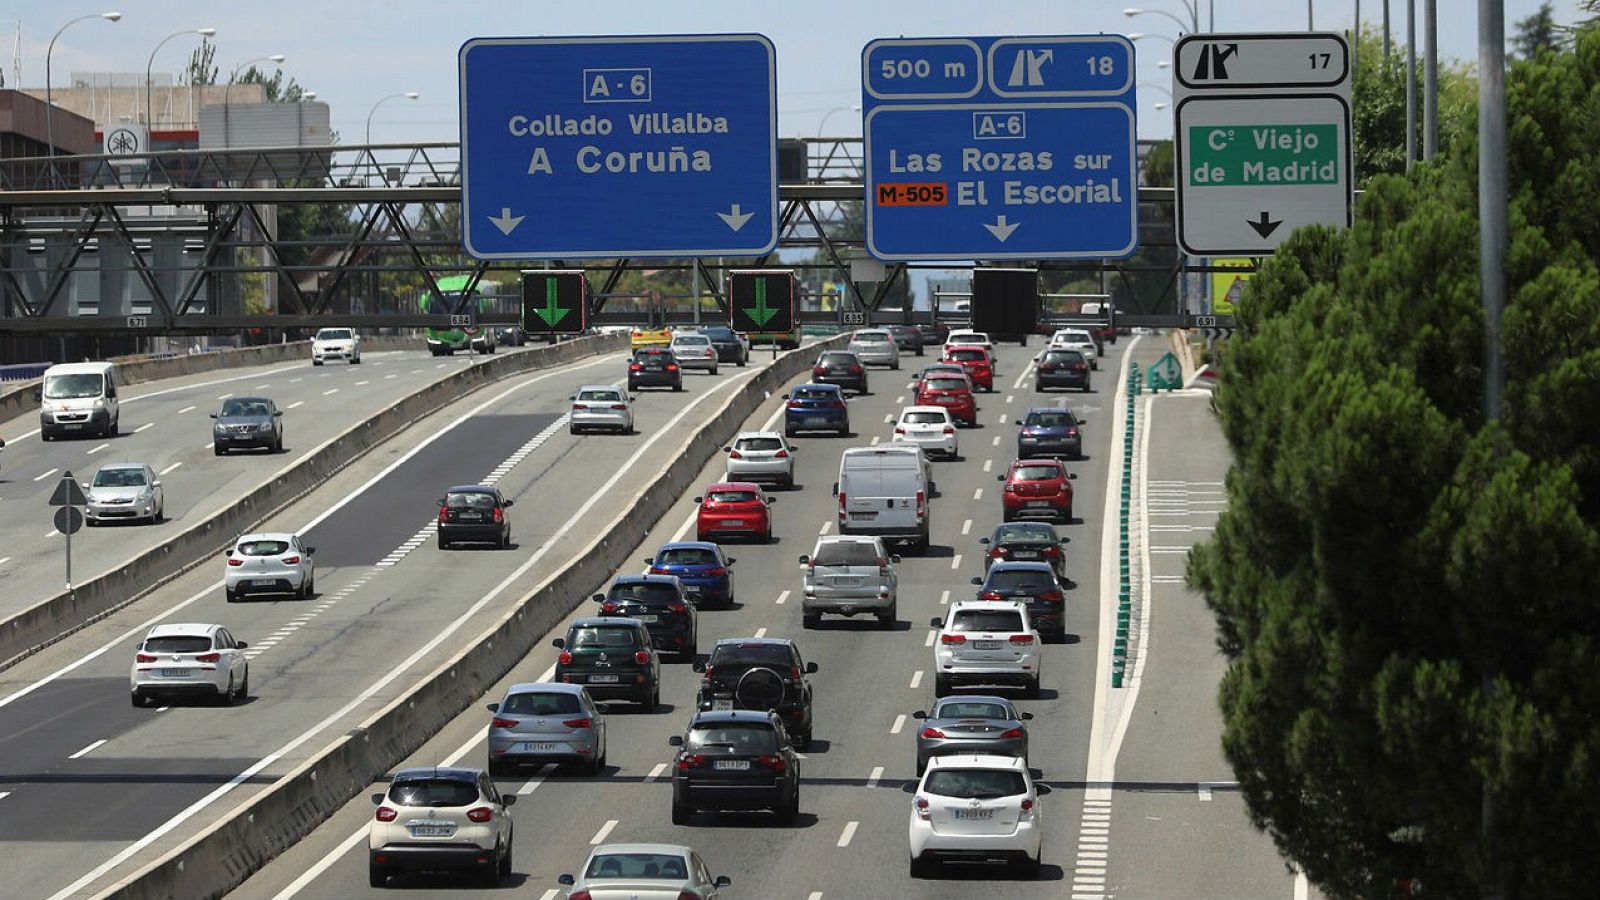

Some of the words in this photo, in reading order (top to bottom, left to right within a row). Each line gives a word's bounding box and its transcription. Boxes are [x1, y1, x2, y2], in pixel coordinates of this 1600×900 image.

[882, 59, 930, 79] 500
[944, 62, 966, 78] m
[1086, 56, 1114, 76] 18
[1309, 53, 1331, 70] 17
[508, 114, 613, 137] Collado
[628, 112, 729, 135] Villalba
[978, 115, 1020, 136] A-6
[1253, 127, 1319, 153] Viejo
[527, 147, 553, 175] A
[576, 145, 712, 174] Coruña
[889, 149, 943, 173] Las
[962, 147, 1053, 172] Rozas
[1073, 154, 1112, 170] sur
[1193, 161, 1226, 183] de
[1243, 160, 1335, 182] Madrid
[879, 186, 945, 204] M-505
[957, 180, 989, 206] El
[1004, 177, 1122, 205] Escorial
